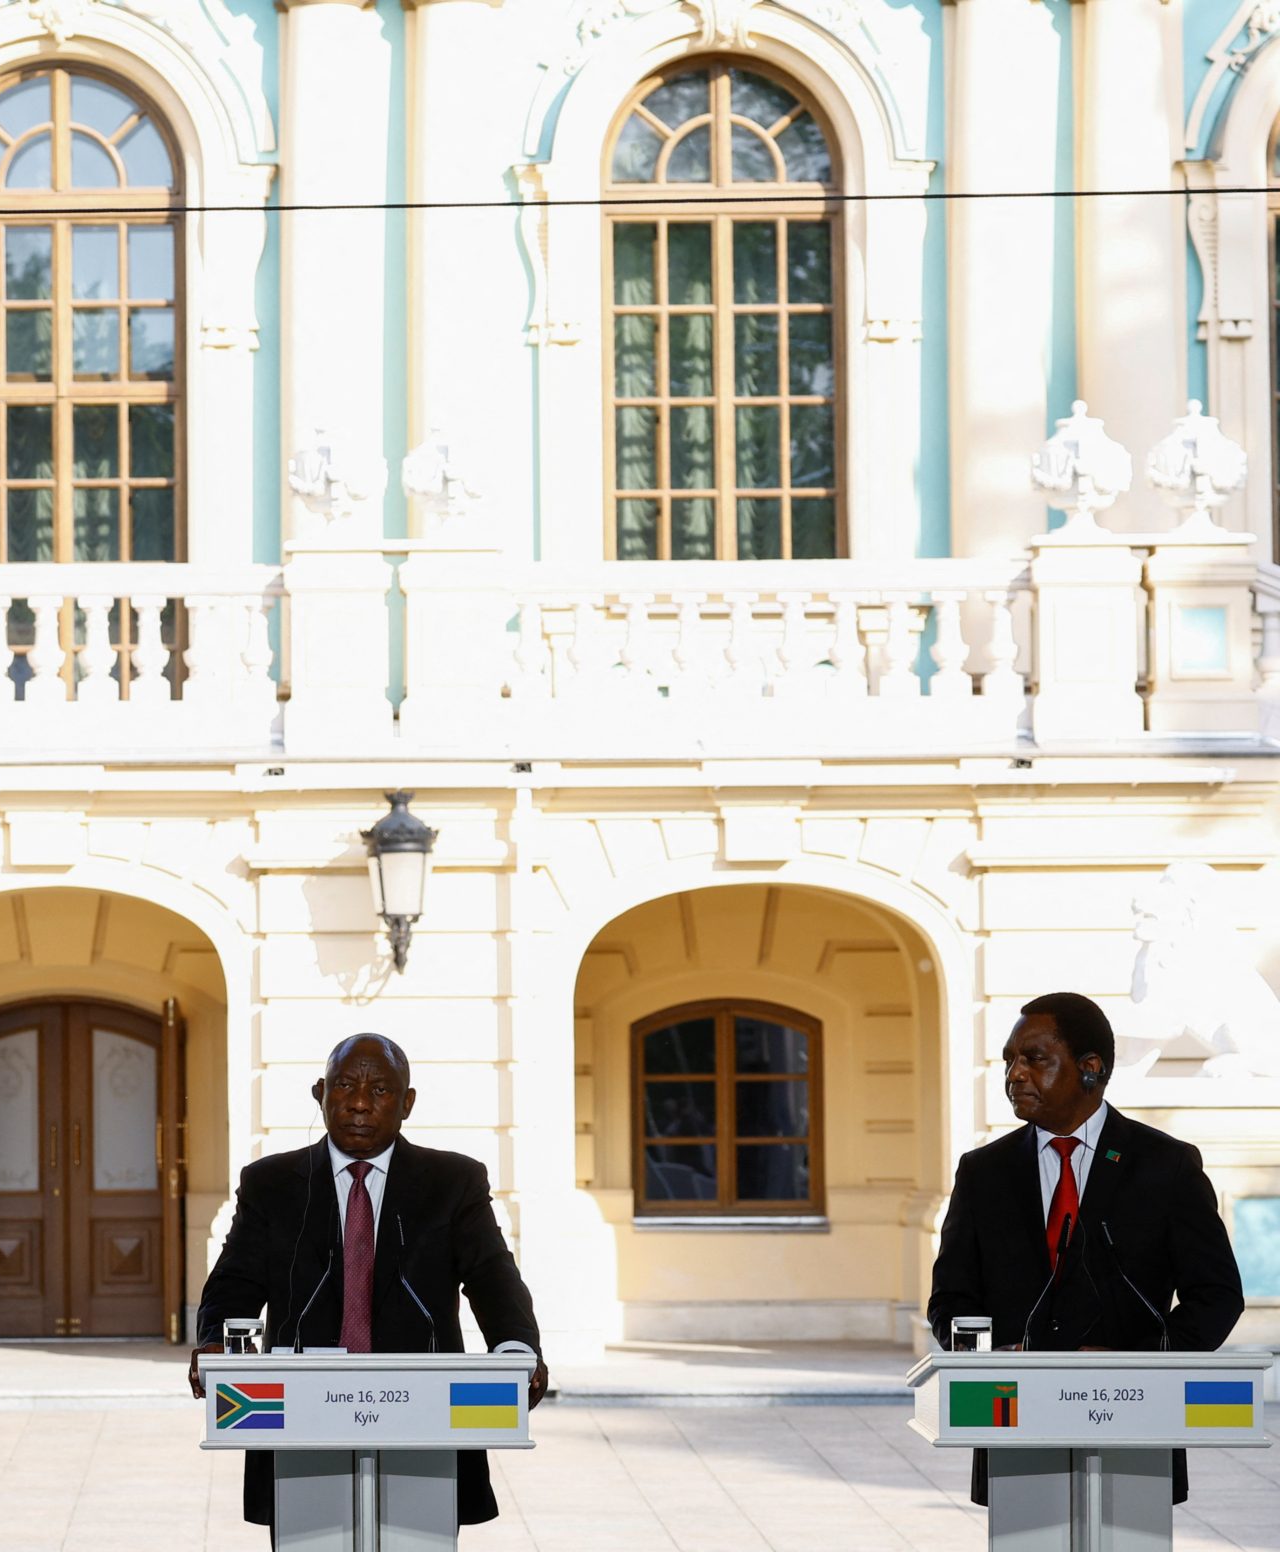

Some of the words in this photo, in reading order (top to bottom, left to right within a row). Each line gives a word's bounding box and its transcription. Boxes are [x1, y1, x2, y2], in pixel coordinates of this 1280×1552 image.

[324, 1390, 354, 1403] June
[358, 1390, 376, 1405] 16,
[379, 1390, 410, 1403] 2023
[1058, 1388, 1089, 1402] June
[1092, 1388, 1111, 1403] 16,
[1113, 1388, 1145, 1402] 2023
[354, 1410, 380, 1426] Kyiv
[1088, 1408, 1114, 1424] Kyiv
